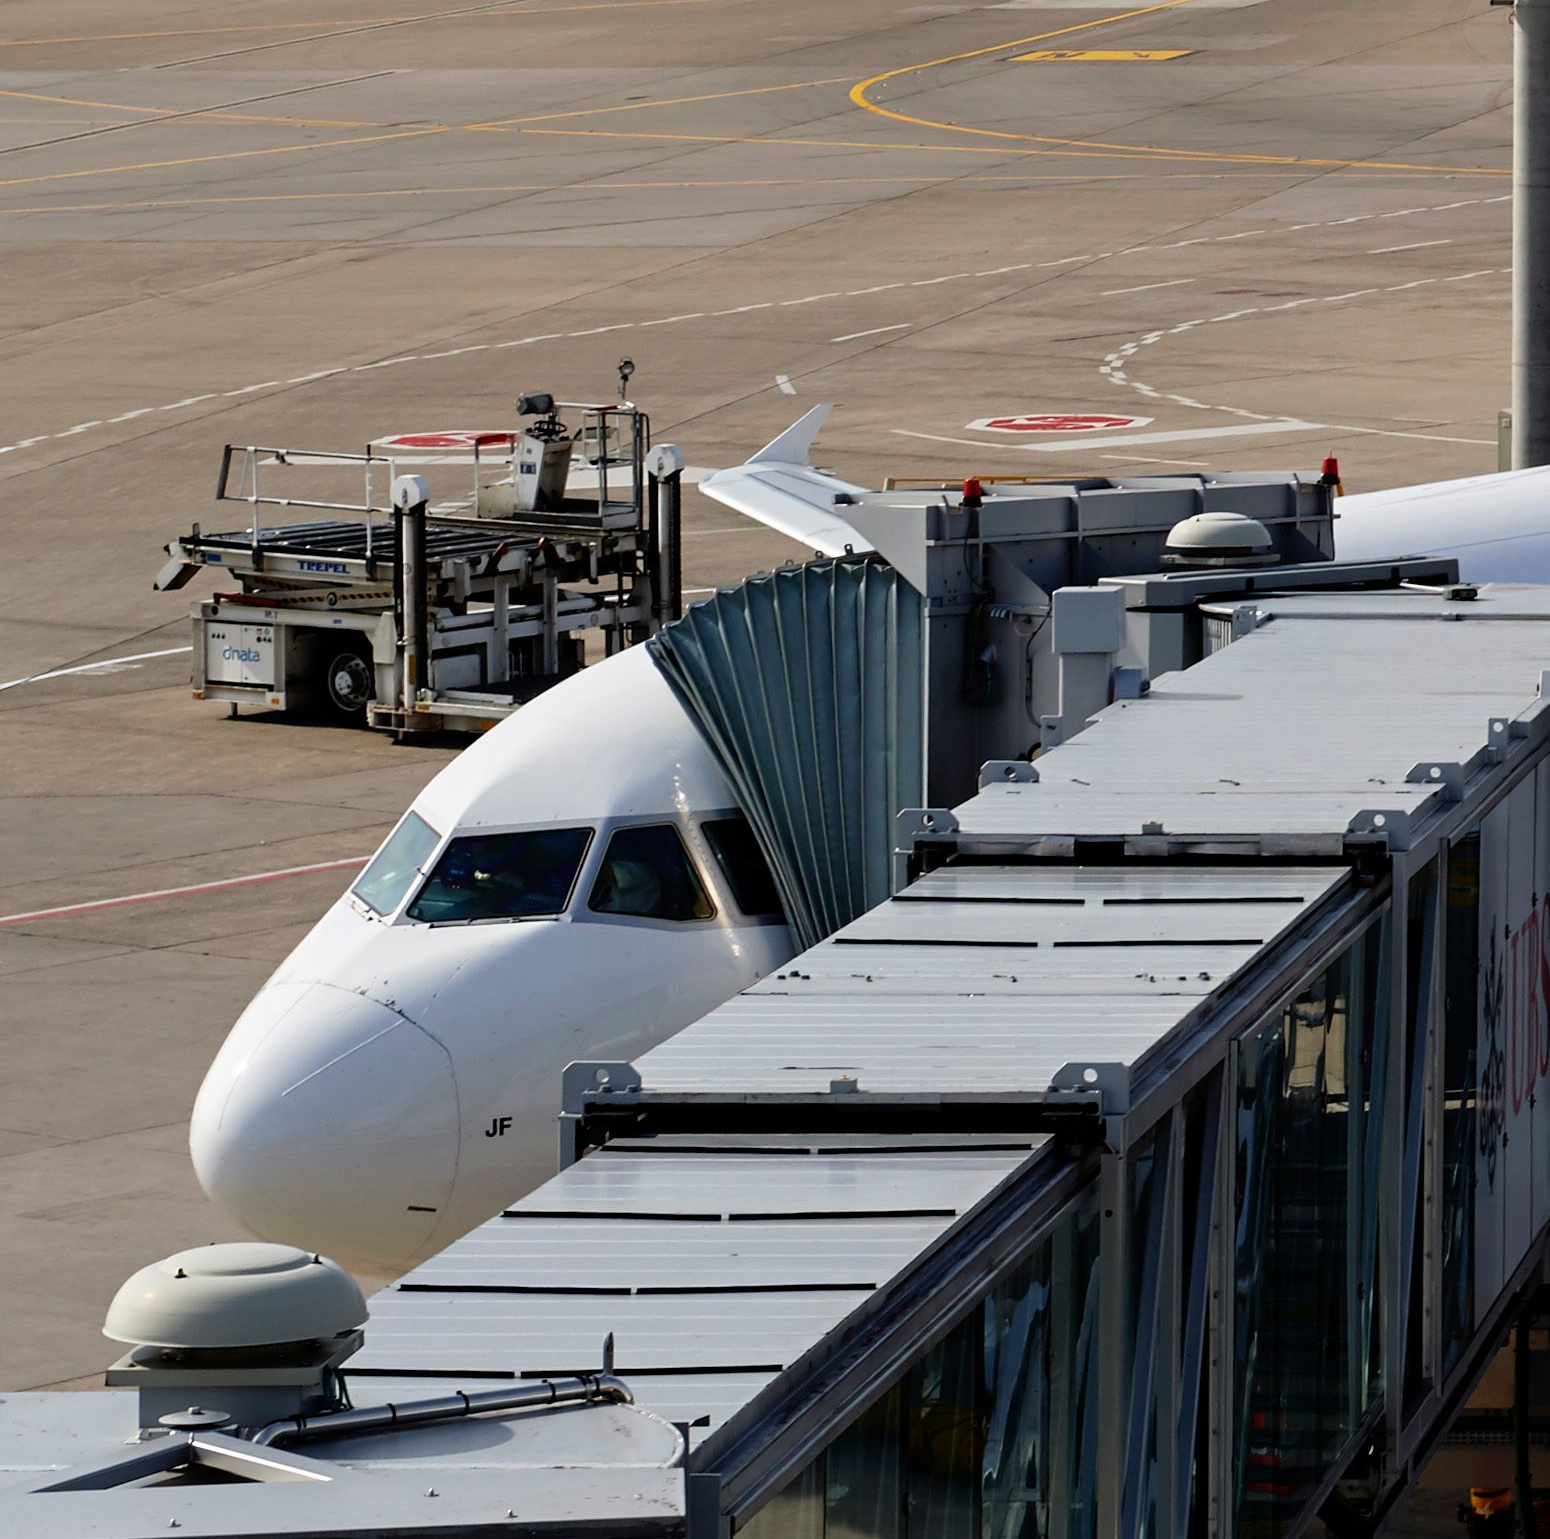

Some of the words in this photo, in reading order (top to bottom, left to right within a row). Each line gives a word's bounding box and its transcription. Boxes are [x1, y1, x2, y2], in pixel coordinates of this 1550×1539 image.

[297, 560, 351, 575] TREPEL
[222, 645, 261, 663] dnata
[485, 1116, 513, 1138] JF
